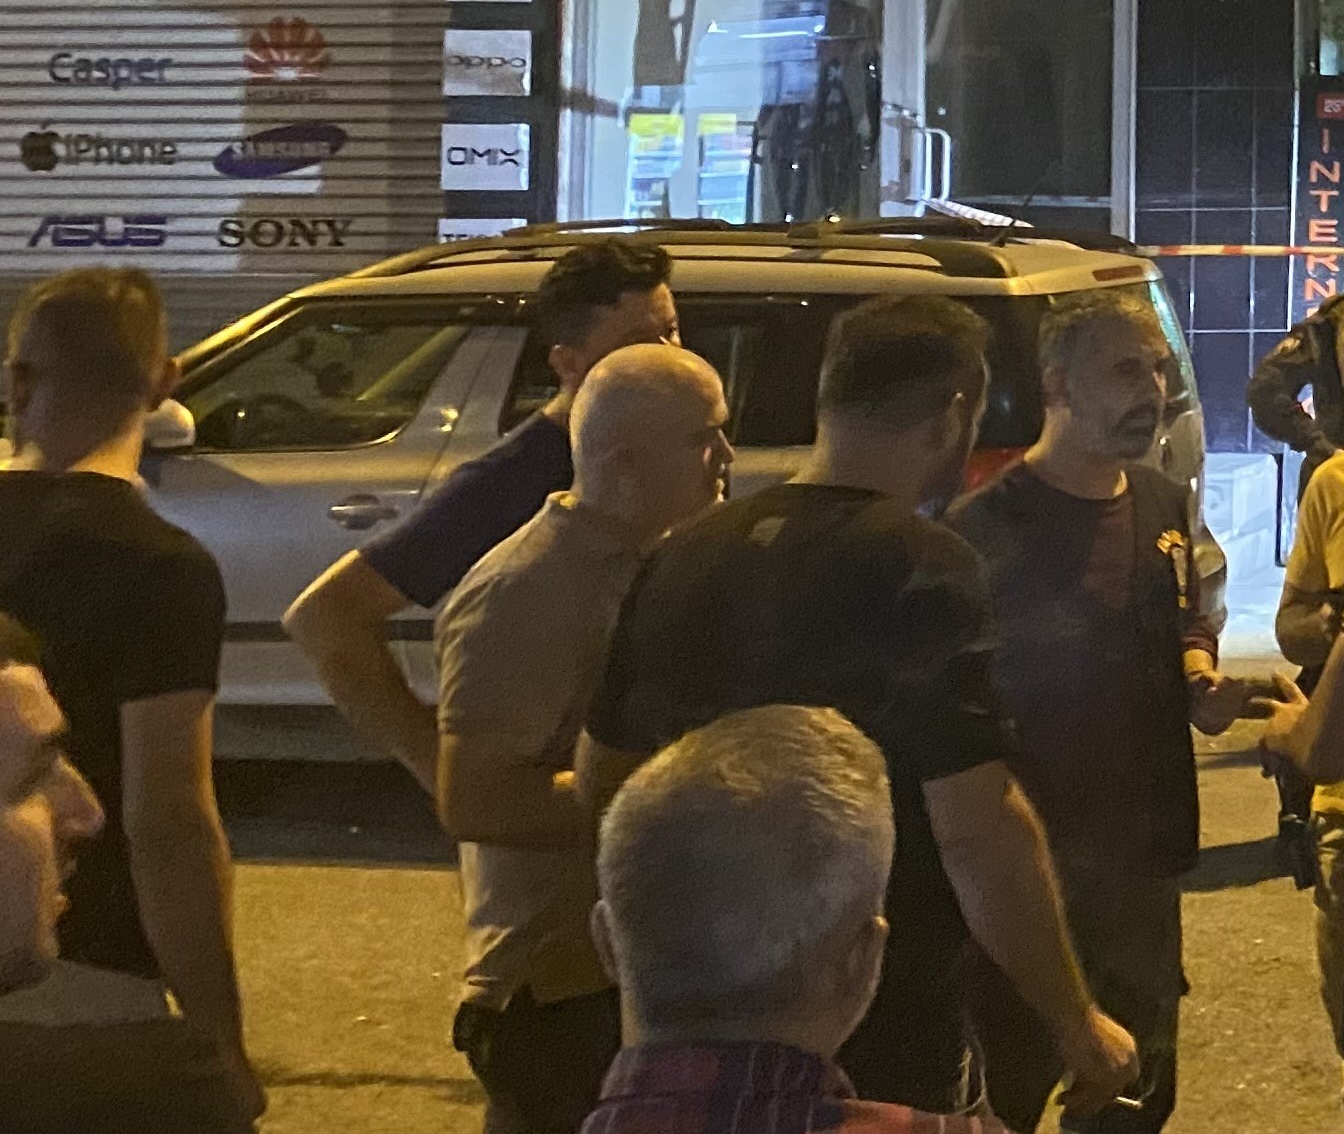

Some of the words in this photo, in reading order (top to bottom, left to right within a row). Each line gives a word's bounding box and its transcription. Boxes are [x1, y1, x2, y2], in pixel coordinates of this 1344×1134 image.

[49, 52, 173, 90] Casper
[64, 133, 176, 165] iPhone
[28, 215, 168, 247] ASUS
[216, 218, 354, 248] SONY
